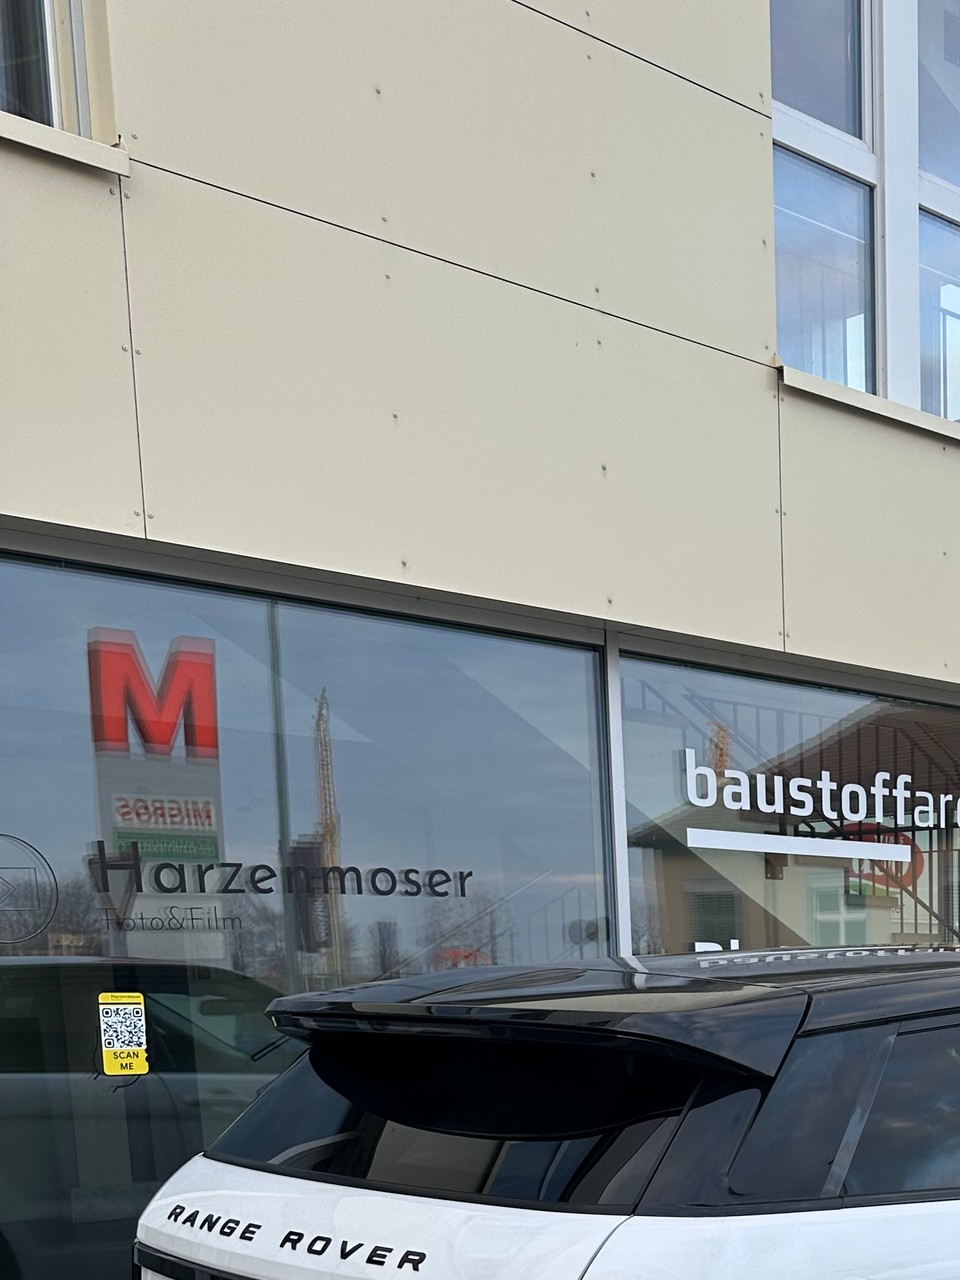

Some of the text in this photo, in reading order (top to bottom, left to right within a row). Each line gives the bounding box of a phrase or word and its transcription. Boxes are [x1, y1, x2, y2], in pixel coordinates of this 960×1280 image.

[97, 840, 473, 898] Harzenmoser
[102, 905, 243, 931] Foto&Film
[113, 1051, 139, 1060] SCAN
[120, 1062, 134, 1070] ME
[167, 1204, 427, 1272] RANGE ROVER
